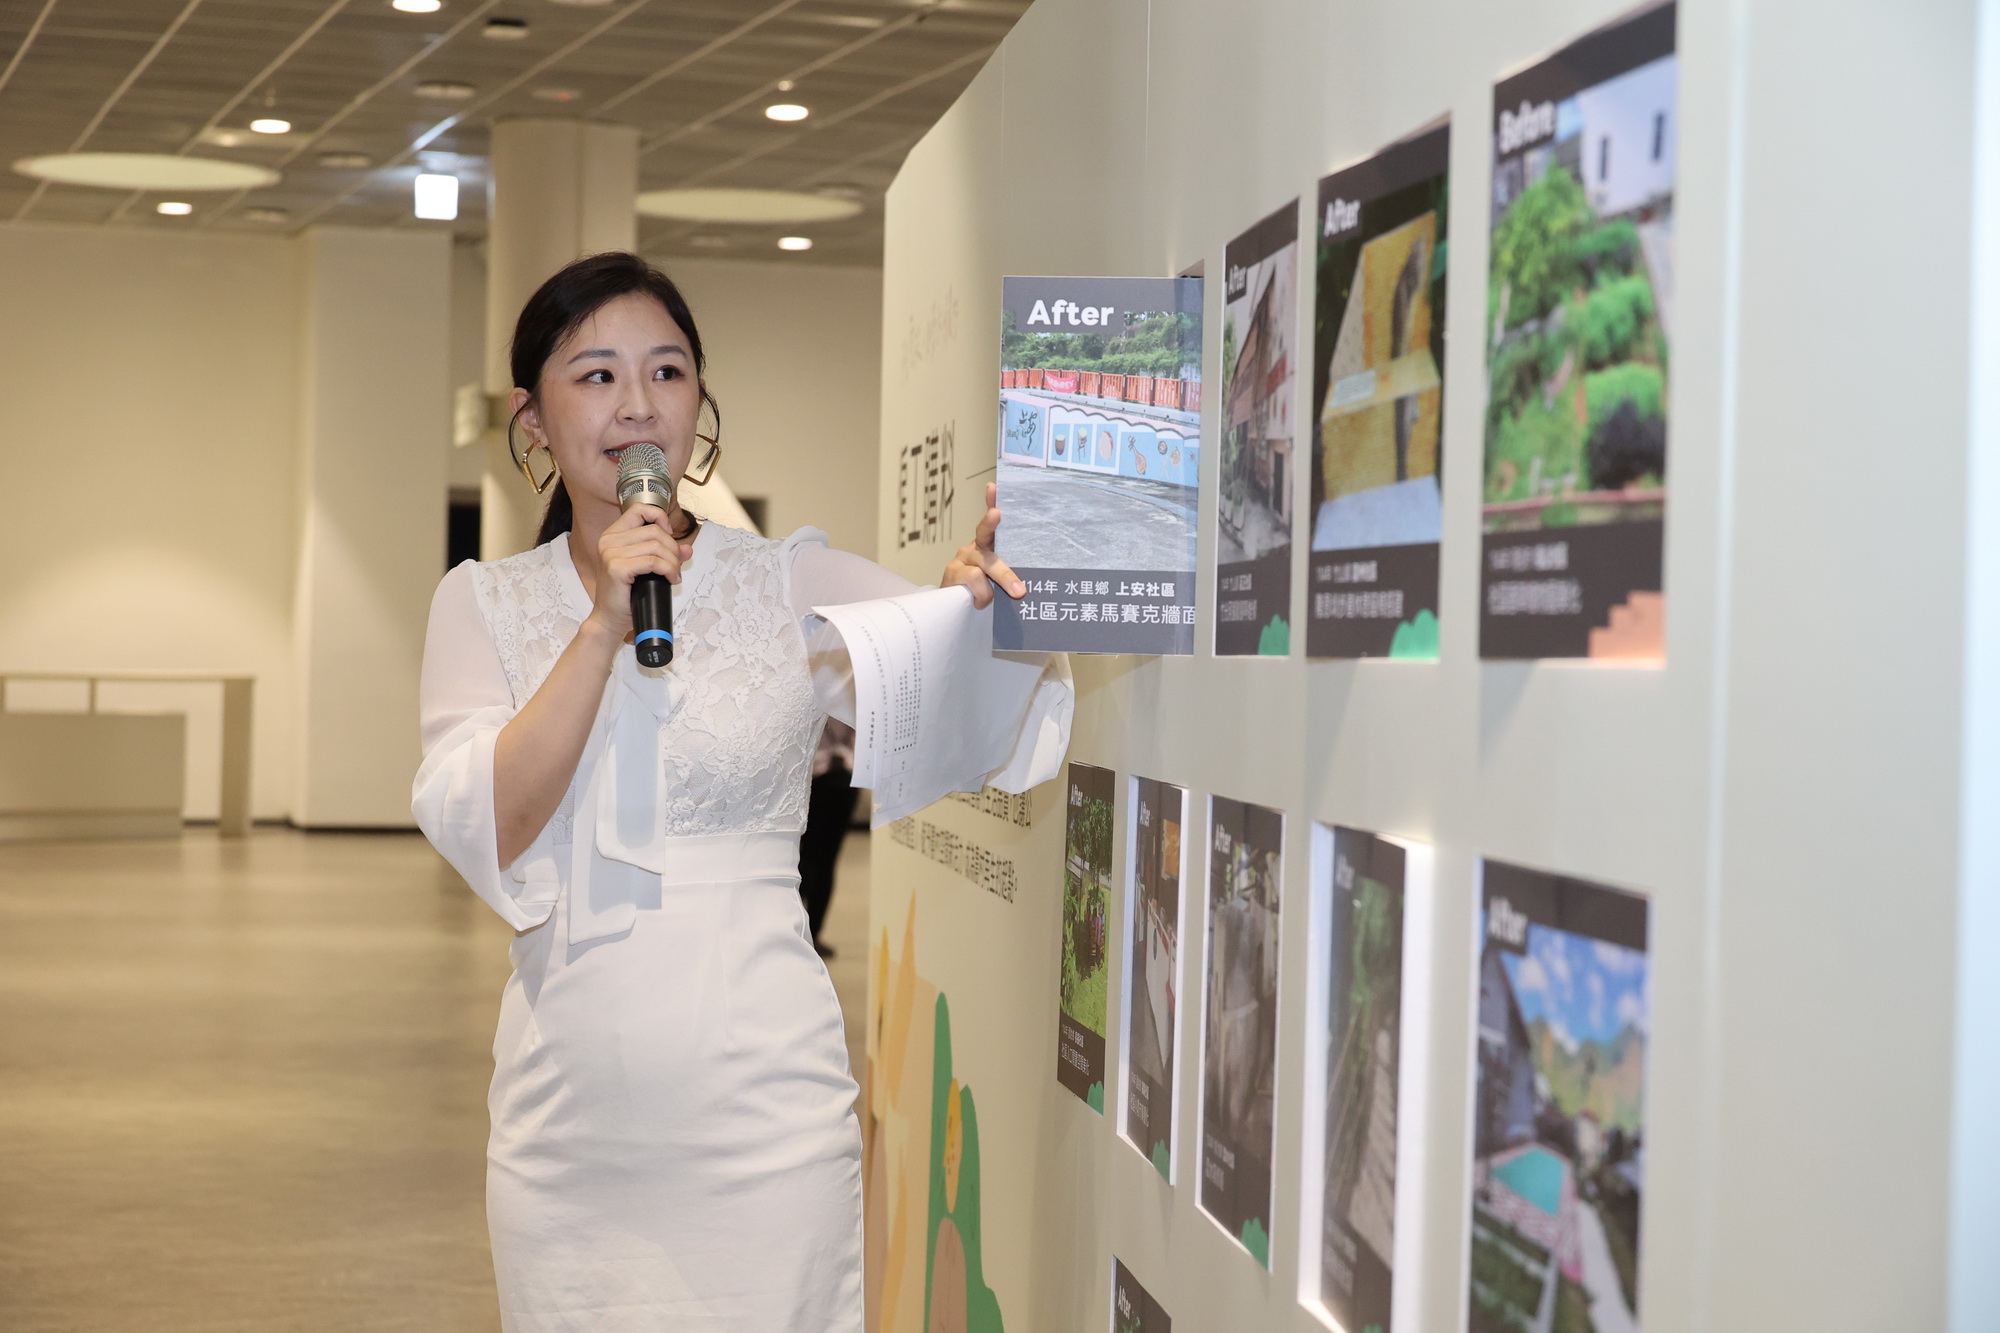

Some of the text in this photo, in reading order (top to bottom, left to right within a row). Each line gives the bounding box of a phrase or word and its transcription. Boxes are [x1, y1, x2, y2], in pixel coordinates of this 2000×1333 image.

[1499, 99, 1554, 154] Before
[1324, 197, 1361, 237] After
[1228, 264, 1247, 296] After
[1026, 299, 1114, 326] After
[1064, 580, 1109, 596] 水里鄉
[1115, 581, 1175, 597] 上安社區
[1019, 601, 1195, 625] 社區元素馬賽克牆面
[1070, 784, 1083, 808] After
[1140, 800, 1151, 828] After
[1215, 823, 1232, 855] After
[1488, 896, 1528, 947] After
[1118, 1284, 1131, 1320] After
